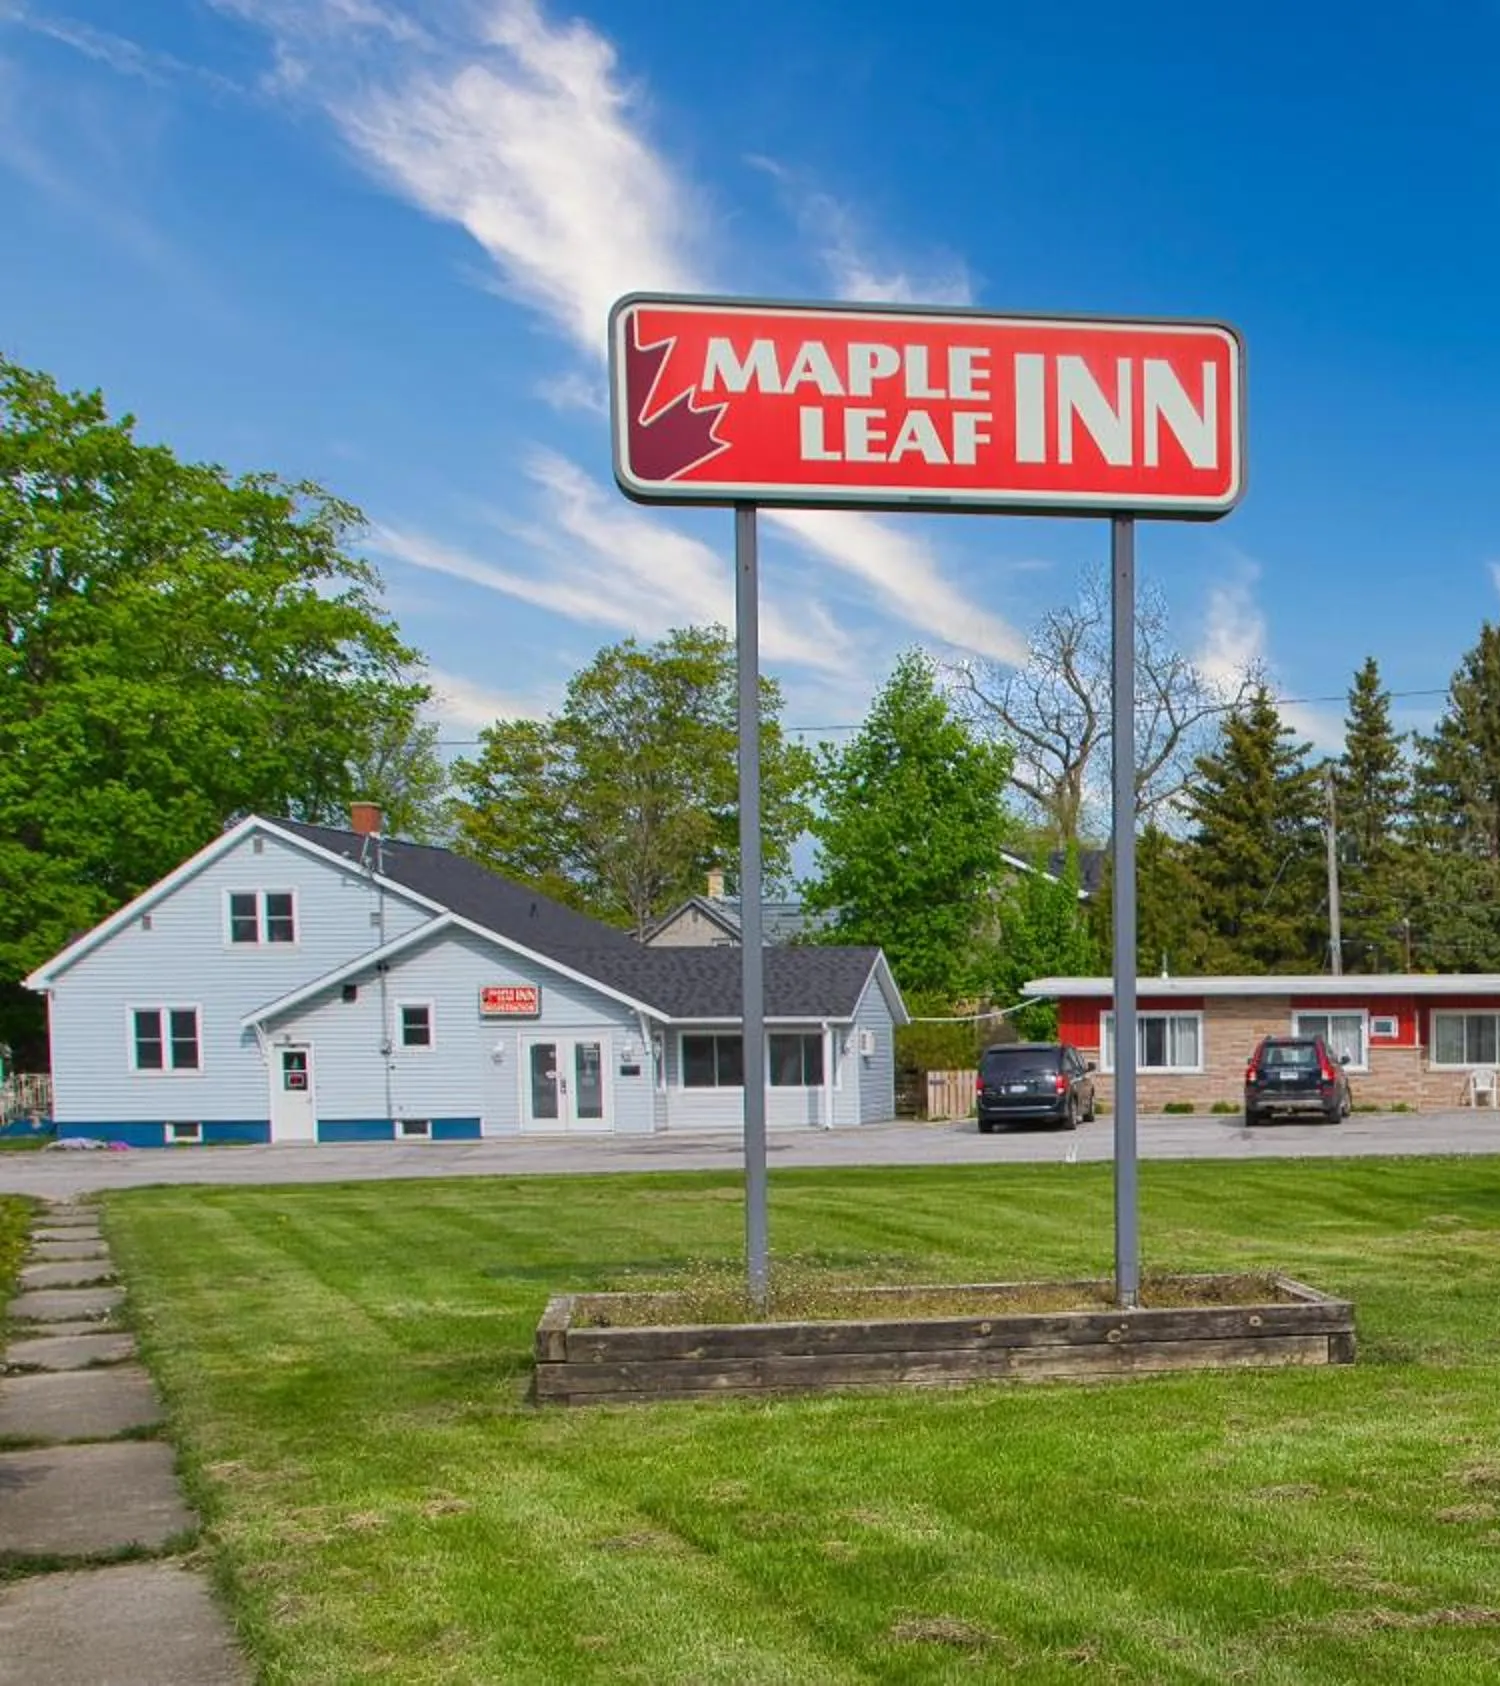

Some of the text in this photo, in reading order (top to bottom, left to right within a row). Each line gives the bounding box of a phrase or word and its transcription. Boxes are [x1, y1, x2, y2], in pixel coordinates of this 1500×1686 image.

[701, 337, 990, 400] MAPLE
[800, 406, 993, 465] LEAF
[1014, 353, 1217, 469] INN
